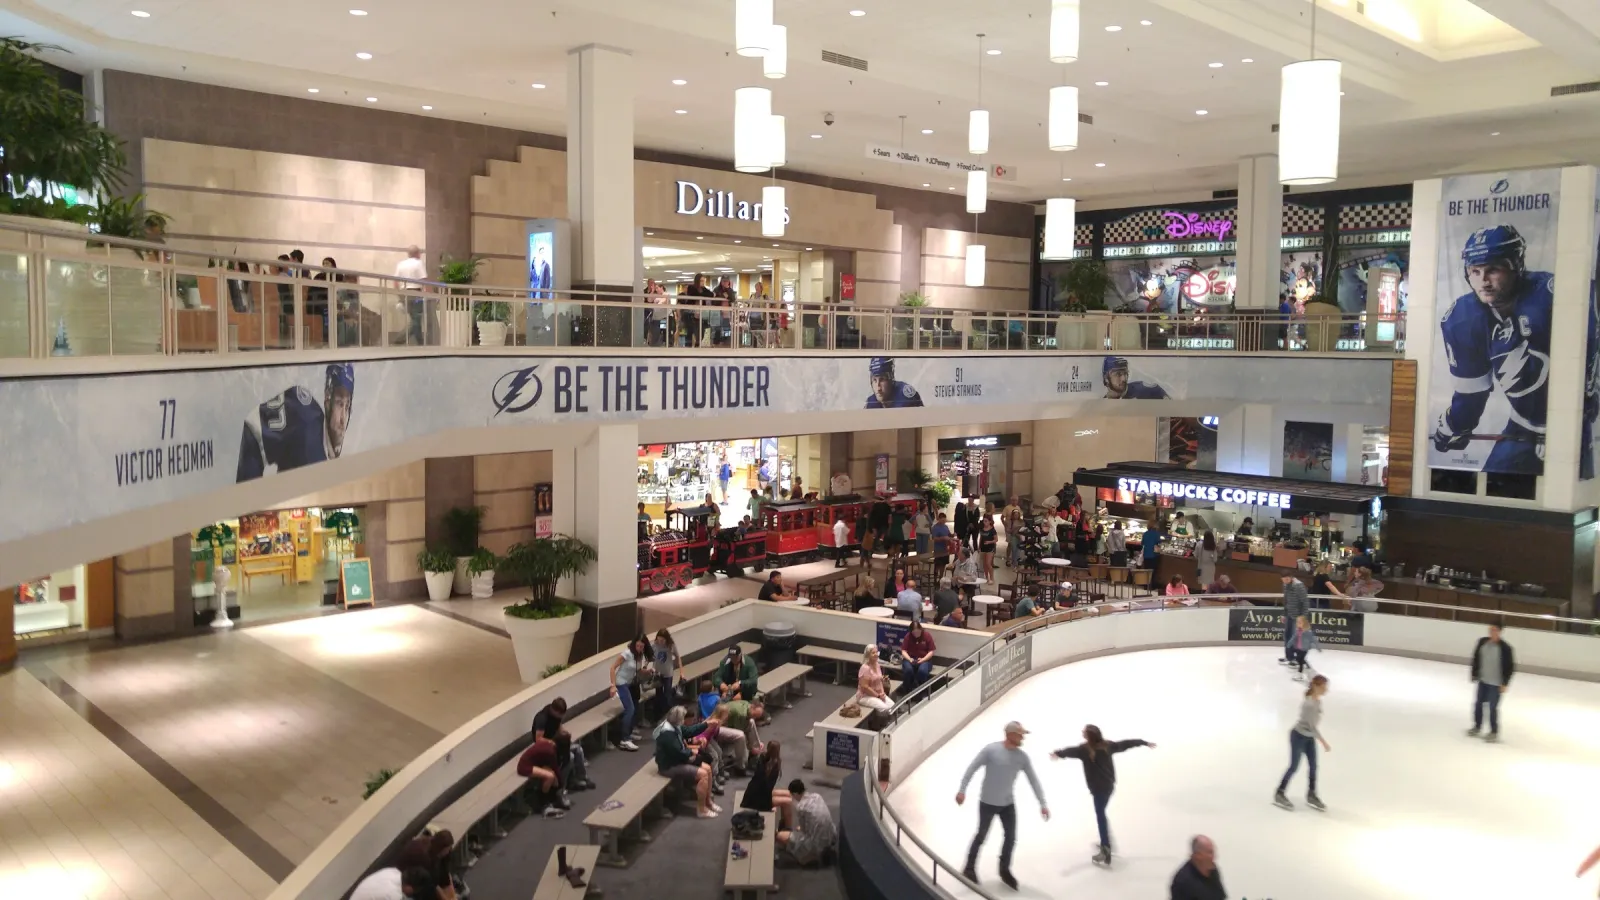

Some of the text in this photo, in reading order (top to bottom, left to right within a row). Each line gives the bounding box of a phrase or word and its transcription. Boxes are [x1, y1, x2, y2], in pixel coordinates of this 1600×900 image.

[877, 148, 891, 158] Sears
[901, 152, 920, 163] Dillard's
[929, 157, 951, 169] JCPenney
[960, 162, 971, 171] Food
[676, 181, 790, 225] Dillars
[1449, 193, 1550, 216] BE THE THUNDER
[955, 367, 963, 382] 91
[1071, 365, 1079, 380] 24
[554, 365, 769, 413] BE THE THUNDER
[935, 384, 982, 398] STEVEN STAMKOS
[1057, 381, 1092, 393] RYAN CALLAHAN
[159, 399, 177, 440] 77
[115, 439, 214, 487] VICTOR HEDMAN
[1118, 477, 1291, 508] STARBUCKS COFFEE
[1243, 610, 1273, 627] Ayo
[1310, 612, 1348, 626] Iken
